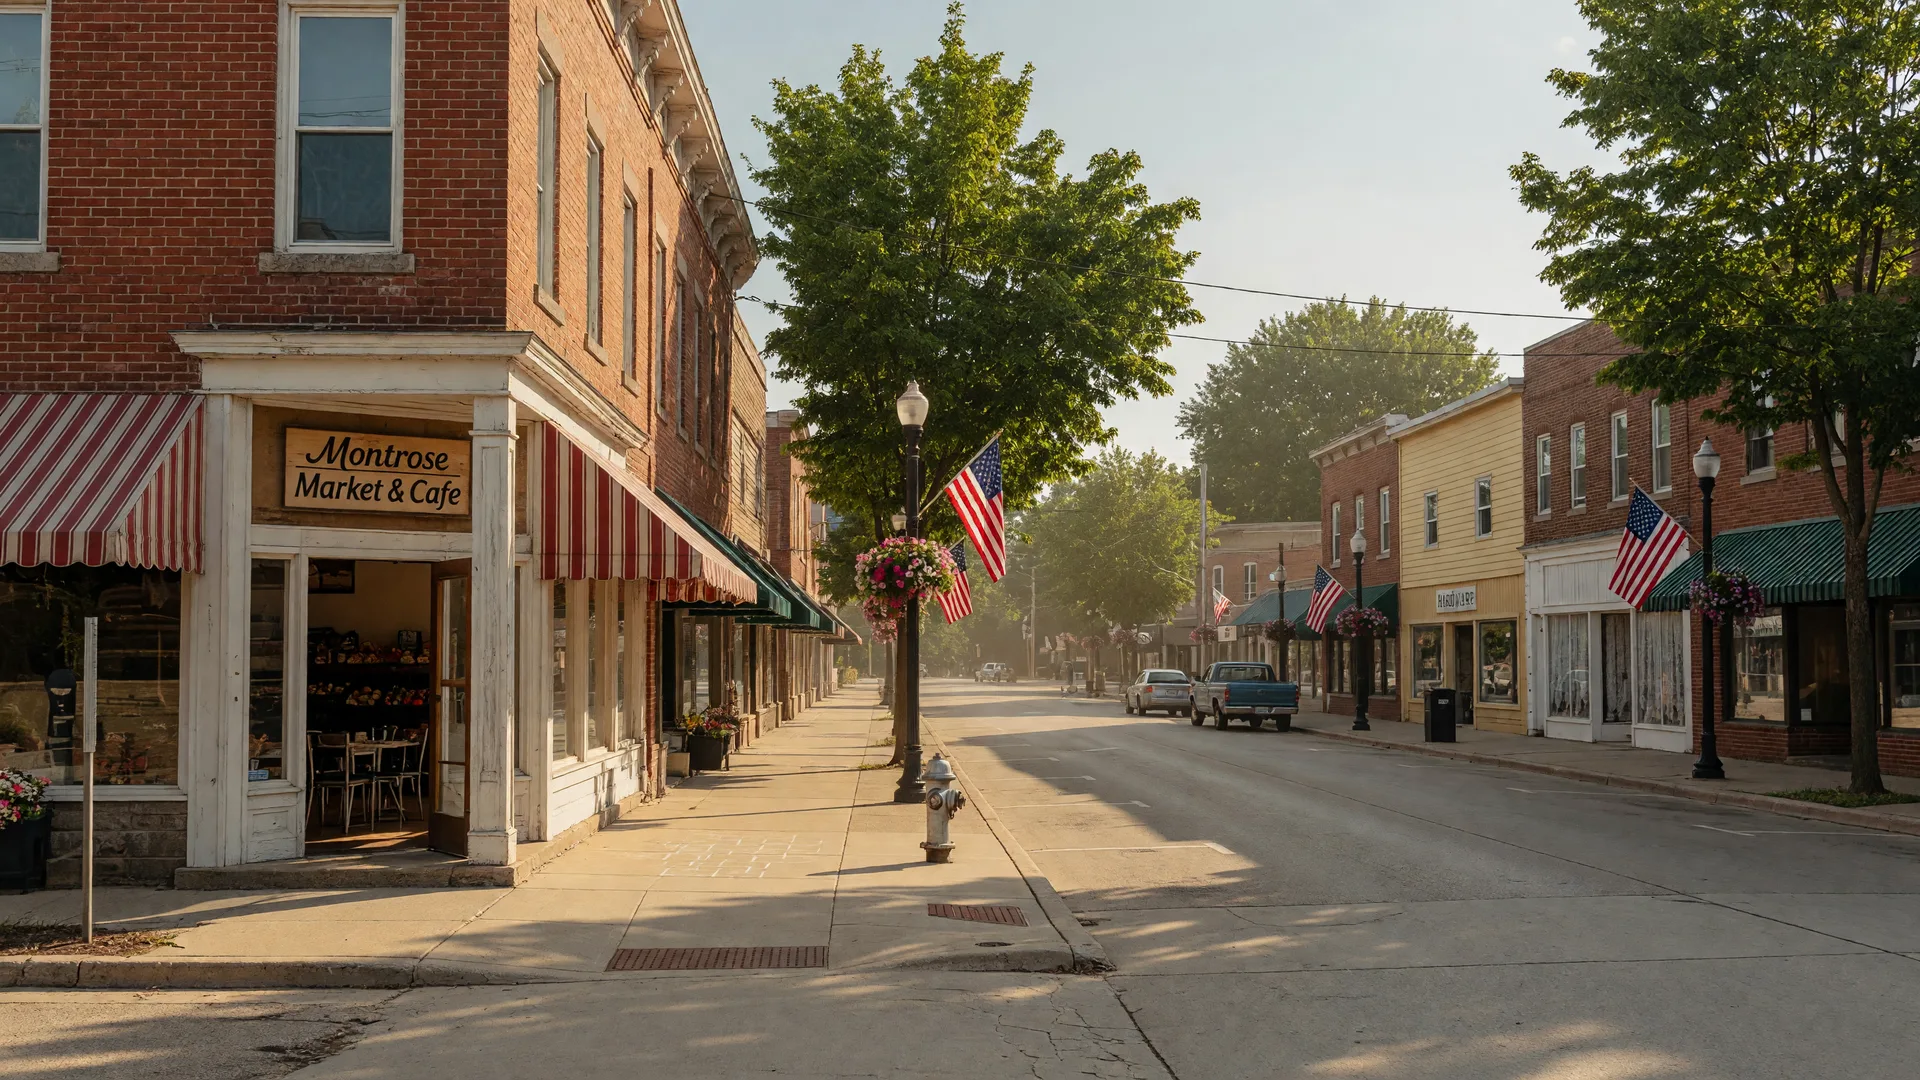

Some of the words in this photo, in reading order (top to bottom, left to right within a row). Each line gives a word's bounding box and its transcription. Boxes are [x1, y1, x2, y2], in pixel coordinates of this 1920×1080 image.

[305, 436, 449, 471] Montrose
[295, 472, 384, 501] Market
[388, 478, 404, 503] &
[410, 479, 461, 510] Cafe
